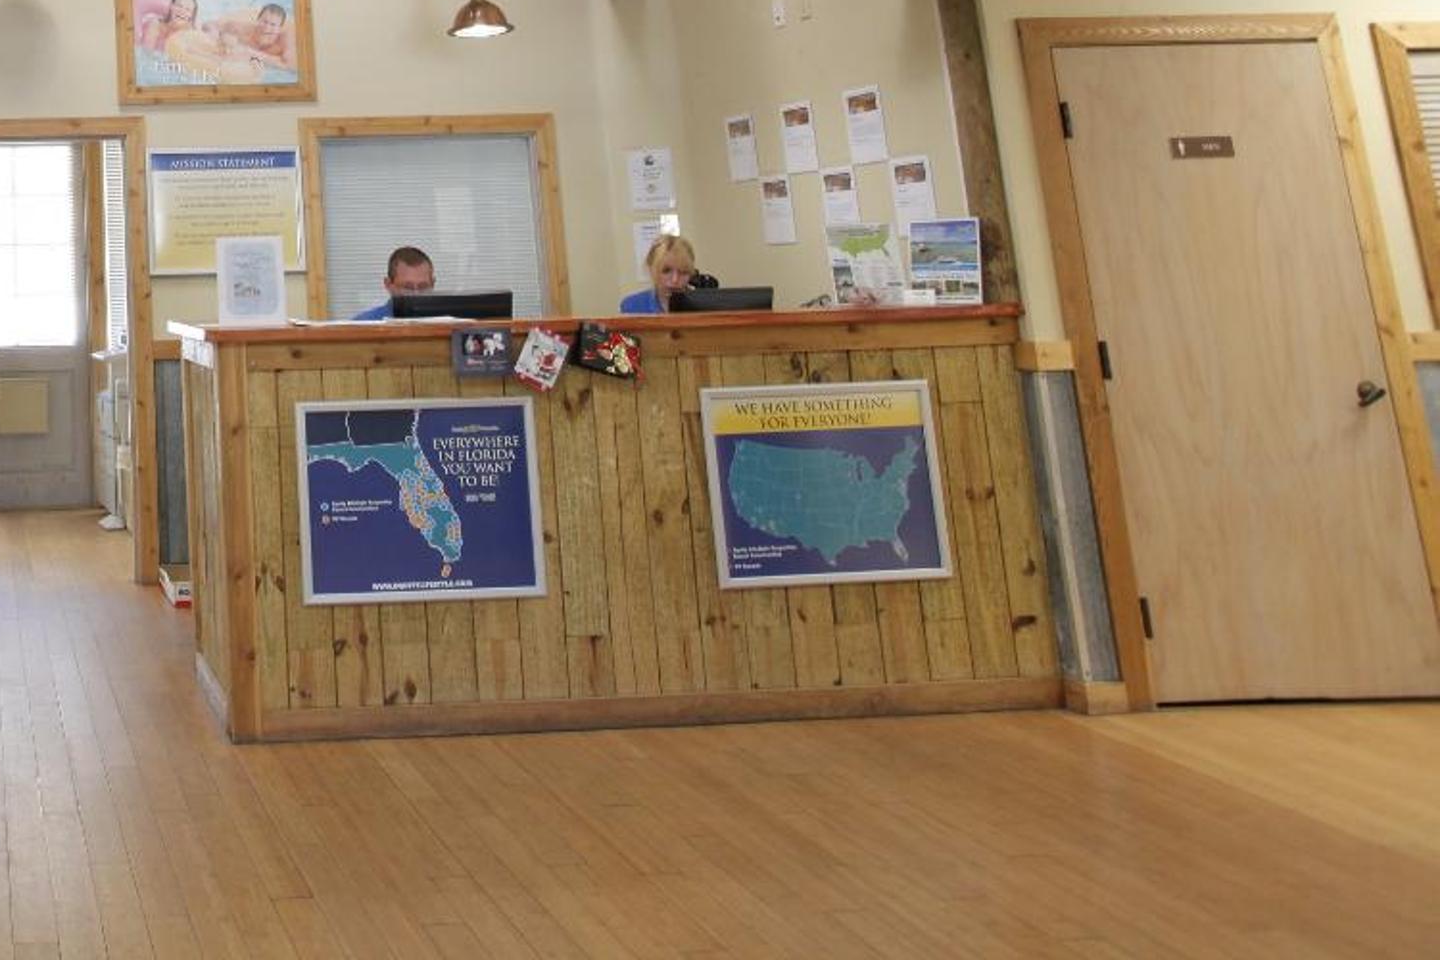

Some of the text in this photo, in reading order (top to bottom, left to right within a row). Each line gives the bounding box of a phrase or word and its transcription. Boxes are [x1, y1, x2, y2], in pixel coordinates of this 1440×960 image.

[170, 156, 276, 169] MISSION STATEMENT
[734, 395, 892, 416] WE HAVE SOMETHING
[760, 414, 788, 429] FOR
[433, 435, 520, 450] EVERYWHERE
[438, 448, 516, 462] IN FLORIDA
[441, 460, 514, 475] YOU WANT
[458, 475, 478, 488] TO
